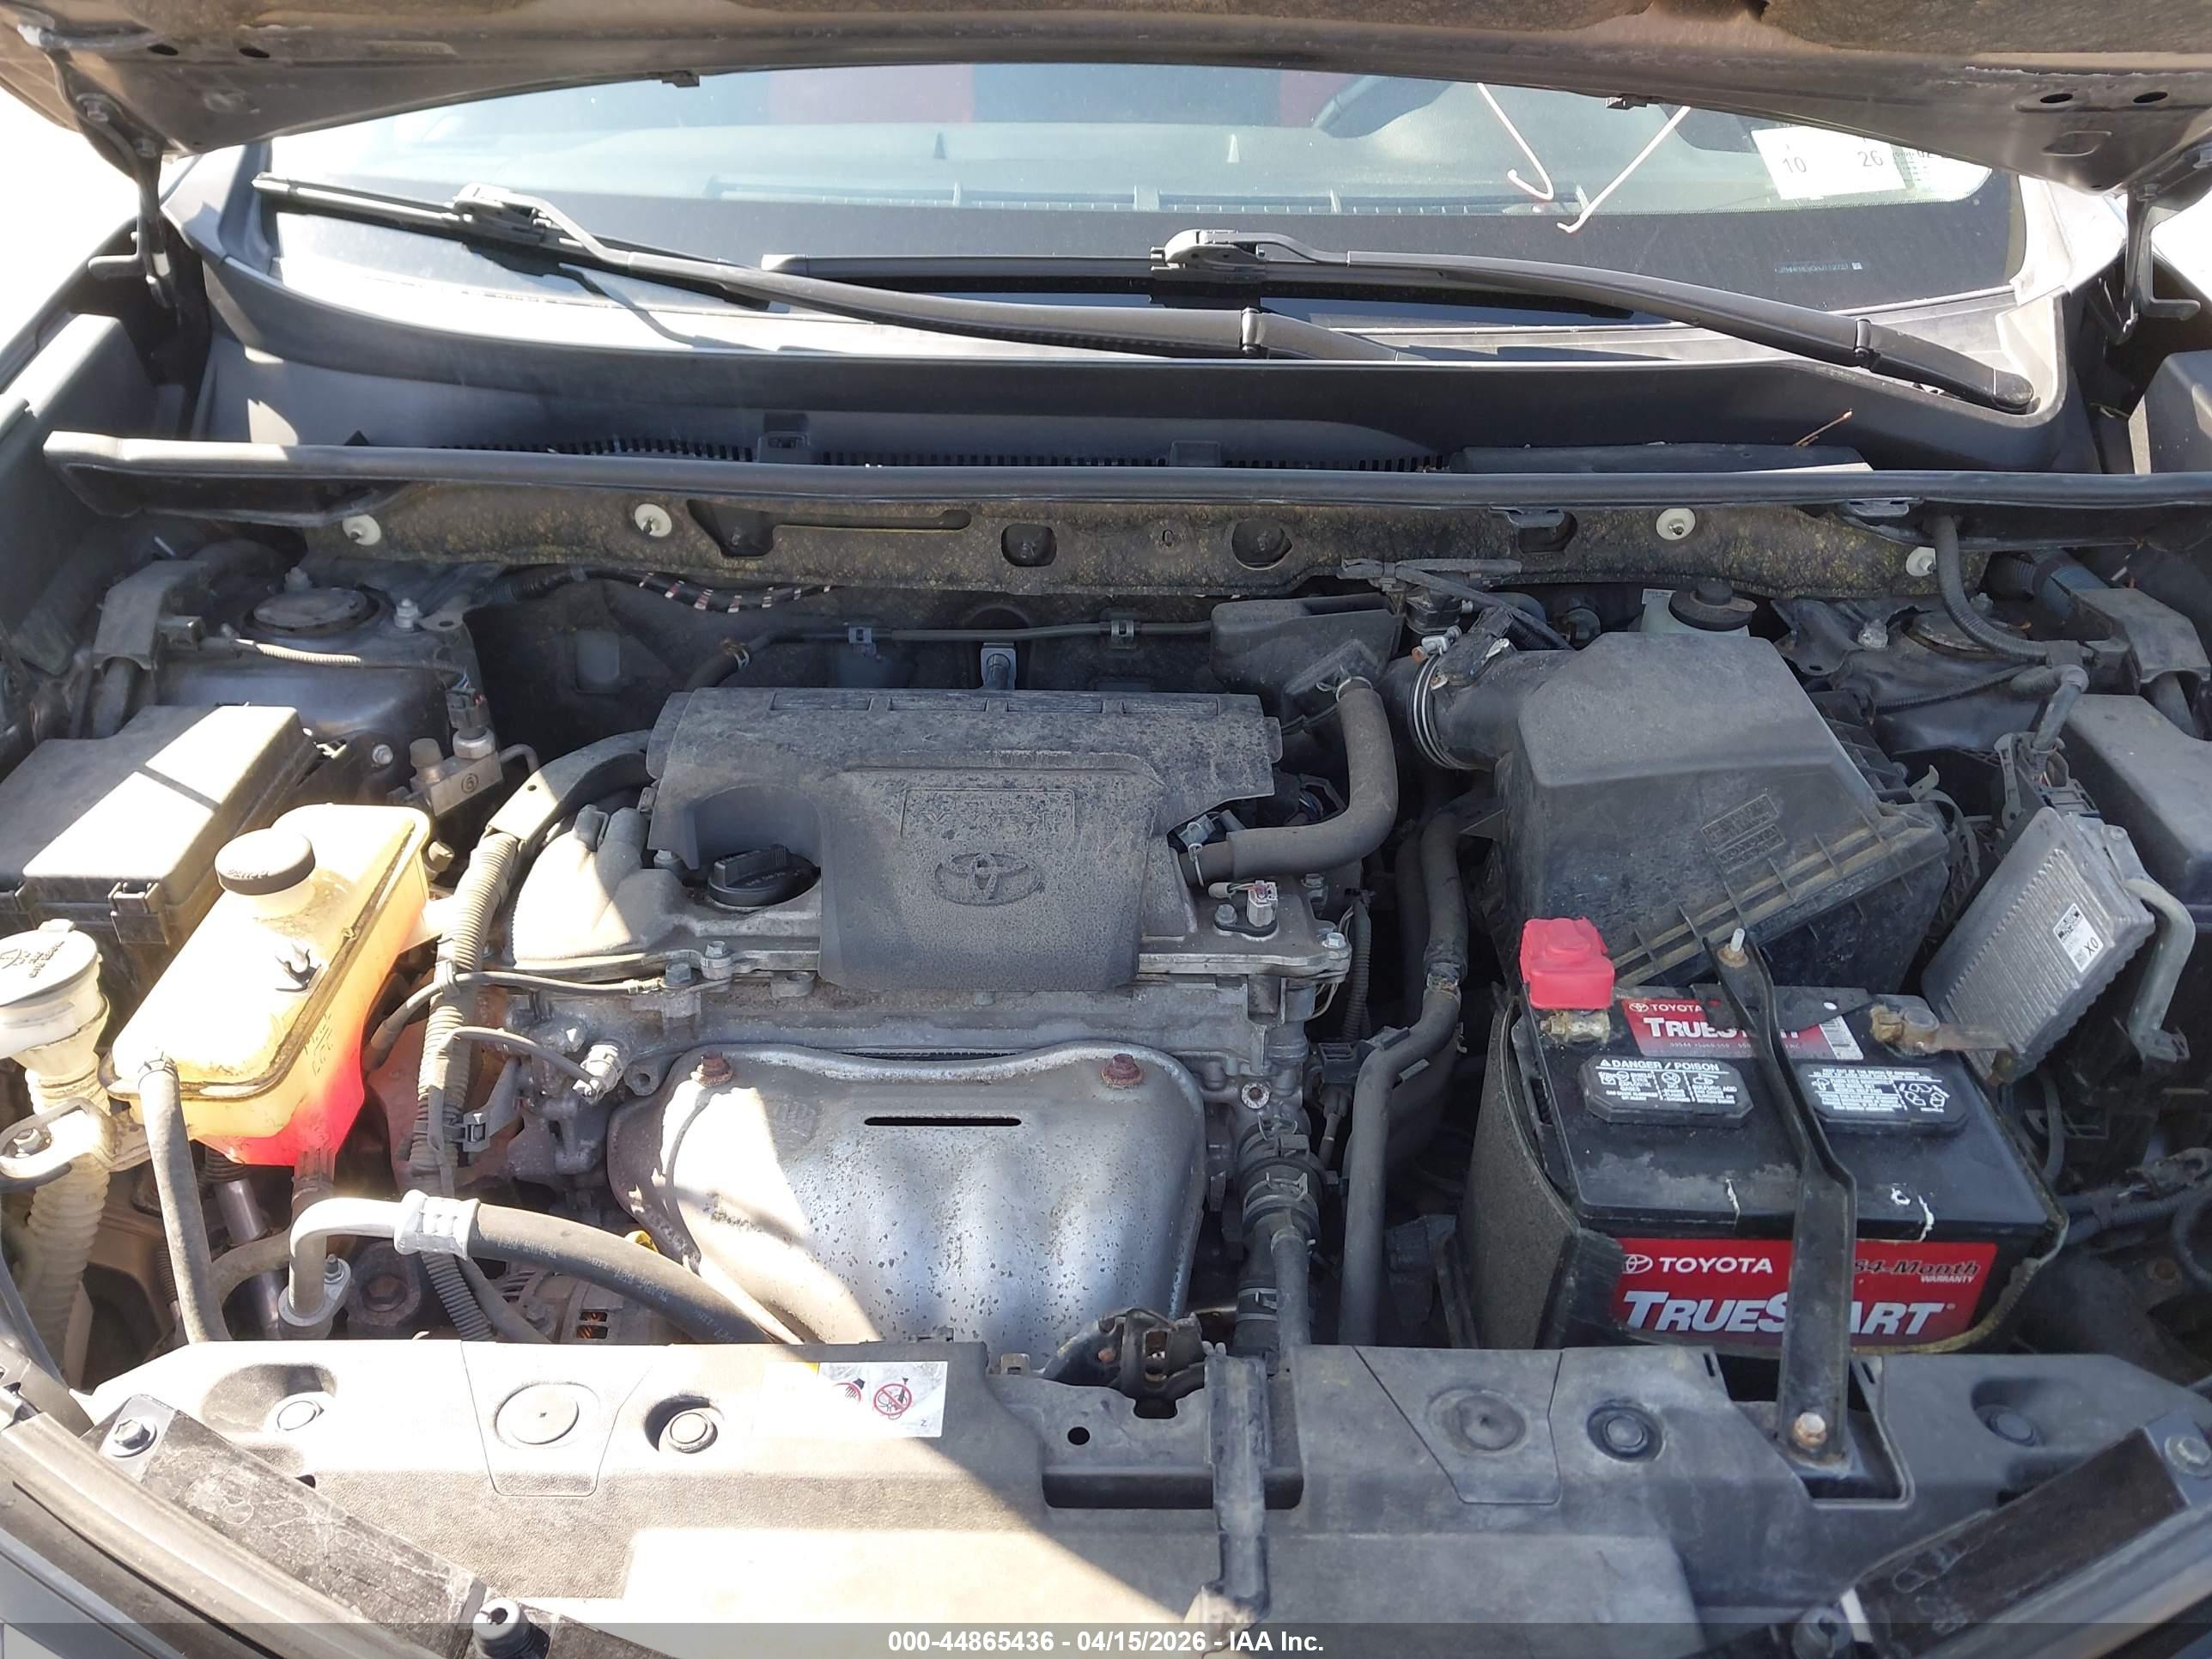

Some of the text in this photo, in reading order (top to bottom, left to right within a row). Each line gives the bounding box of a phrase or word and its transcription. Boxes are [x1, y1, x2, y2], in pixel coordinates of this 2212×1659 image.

[1782, 156, 1807, 173] 10
[1857, 149, 1883, 167] 26
[1650, 1003, 1703, 1012] TOYOTA
[1612, 1060, 1662, 1070] DANGER
[1674, 1062, 1720, 1071] POISON
[1659, 1257, 1773, 1273] TOYOTA
[1920, 1275, 1974, 1284] WARRANTY
[1624, 1291, 1945, 1334] TRUESRT
